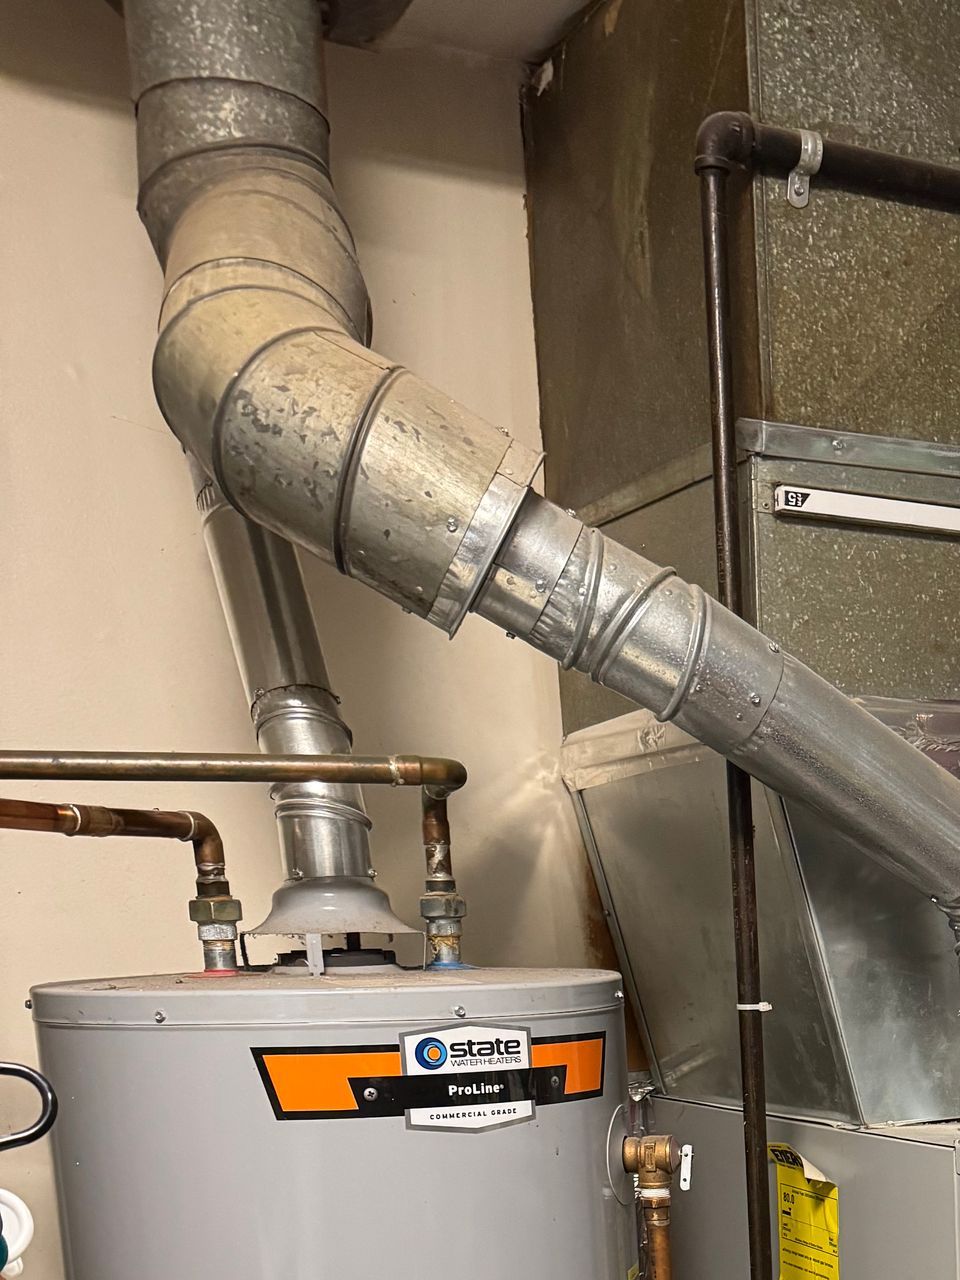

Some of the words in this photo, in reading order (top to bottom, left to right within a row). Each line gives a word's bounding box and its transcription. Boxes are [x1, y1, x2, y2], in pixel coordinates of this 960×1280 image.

[788, 492, 796, 505] 5
[450, 1038, 520, 1058] state
[451, 1058, 482, 1067] WATER
[484, 1056, 521, 1065] HEATERS
[430, 1111, 487, 1120] COMMERCIAL
[783, 1192, 794, 1204] 80.0
